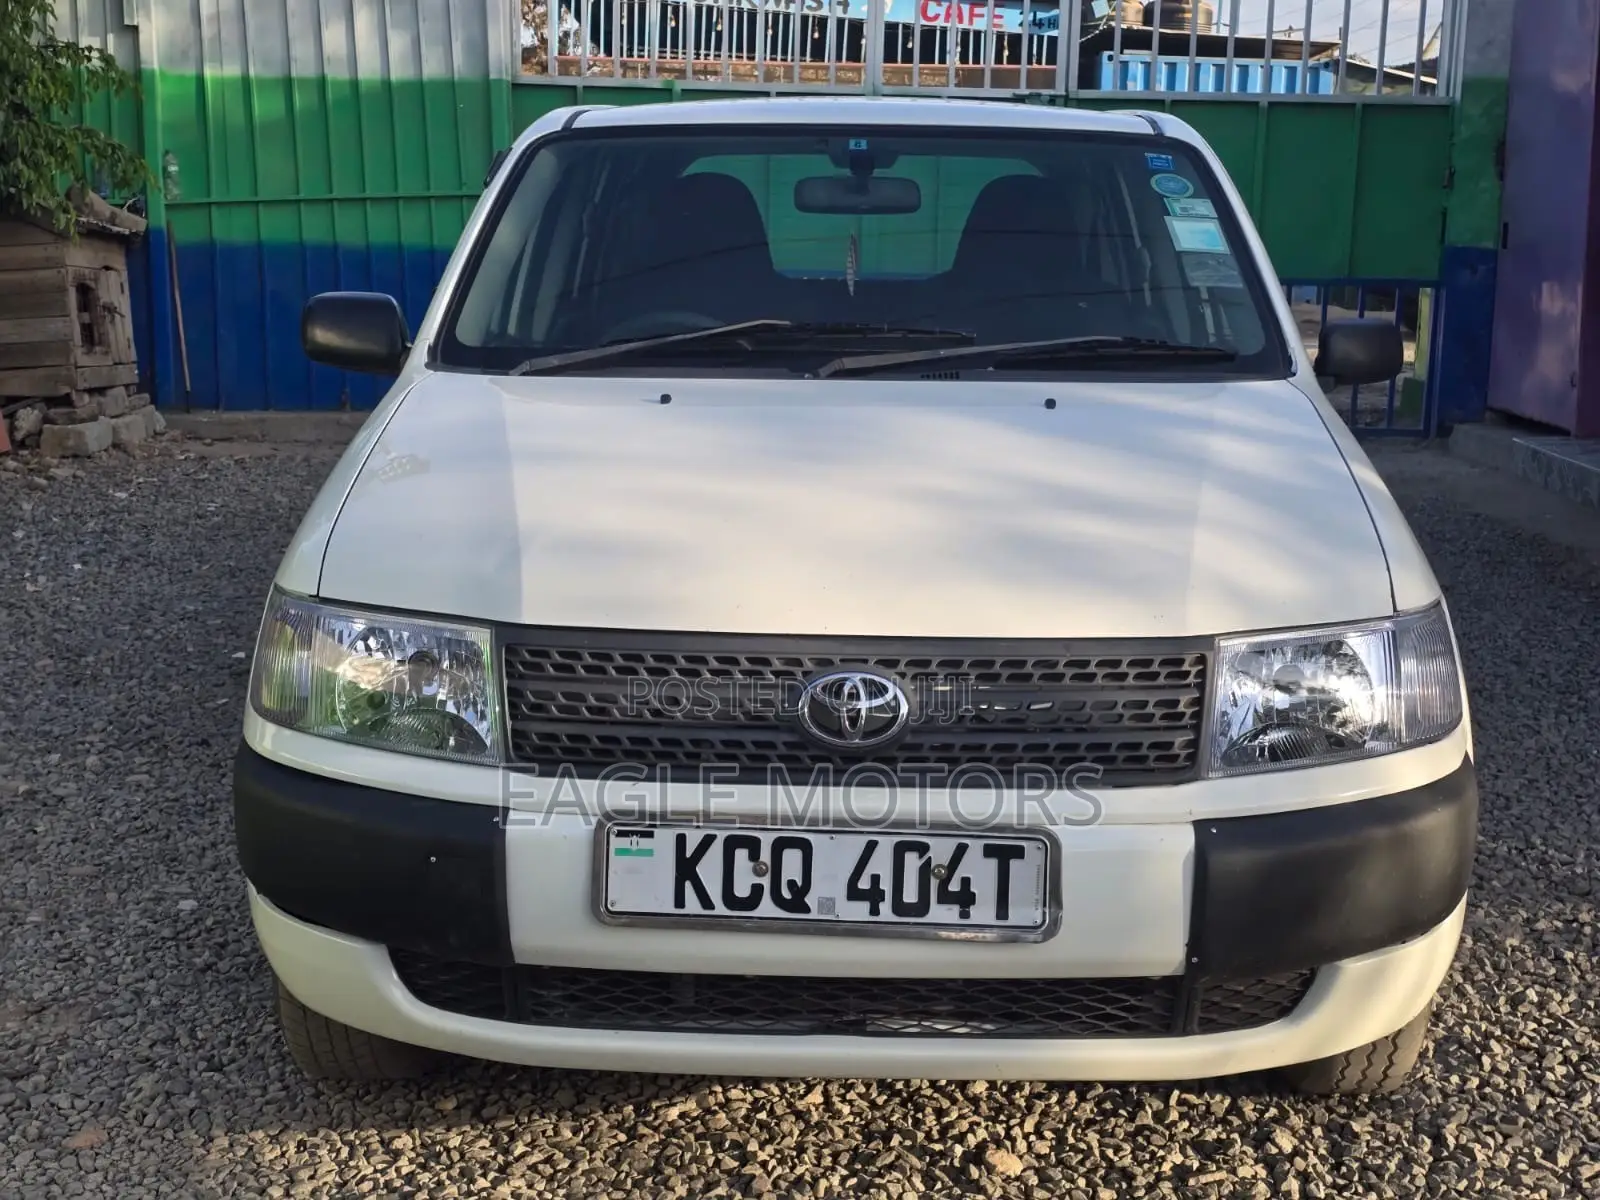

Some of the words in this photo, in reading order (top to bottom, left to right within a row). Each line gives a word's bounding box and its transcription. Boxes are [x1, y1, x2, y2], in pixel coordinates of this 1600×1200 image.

[920, 0, 1004, 29] CAFE
[673, 833, 813, 914] KCQ
[846, 839, 1025, 921] 404T
